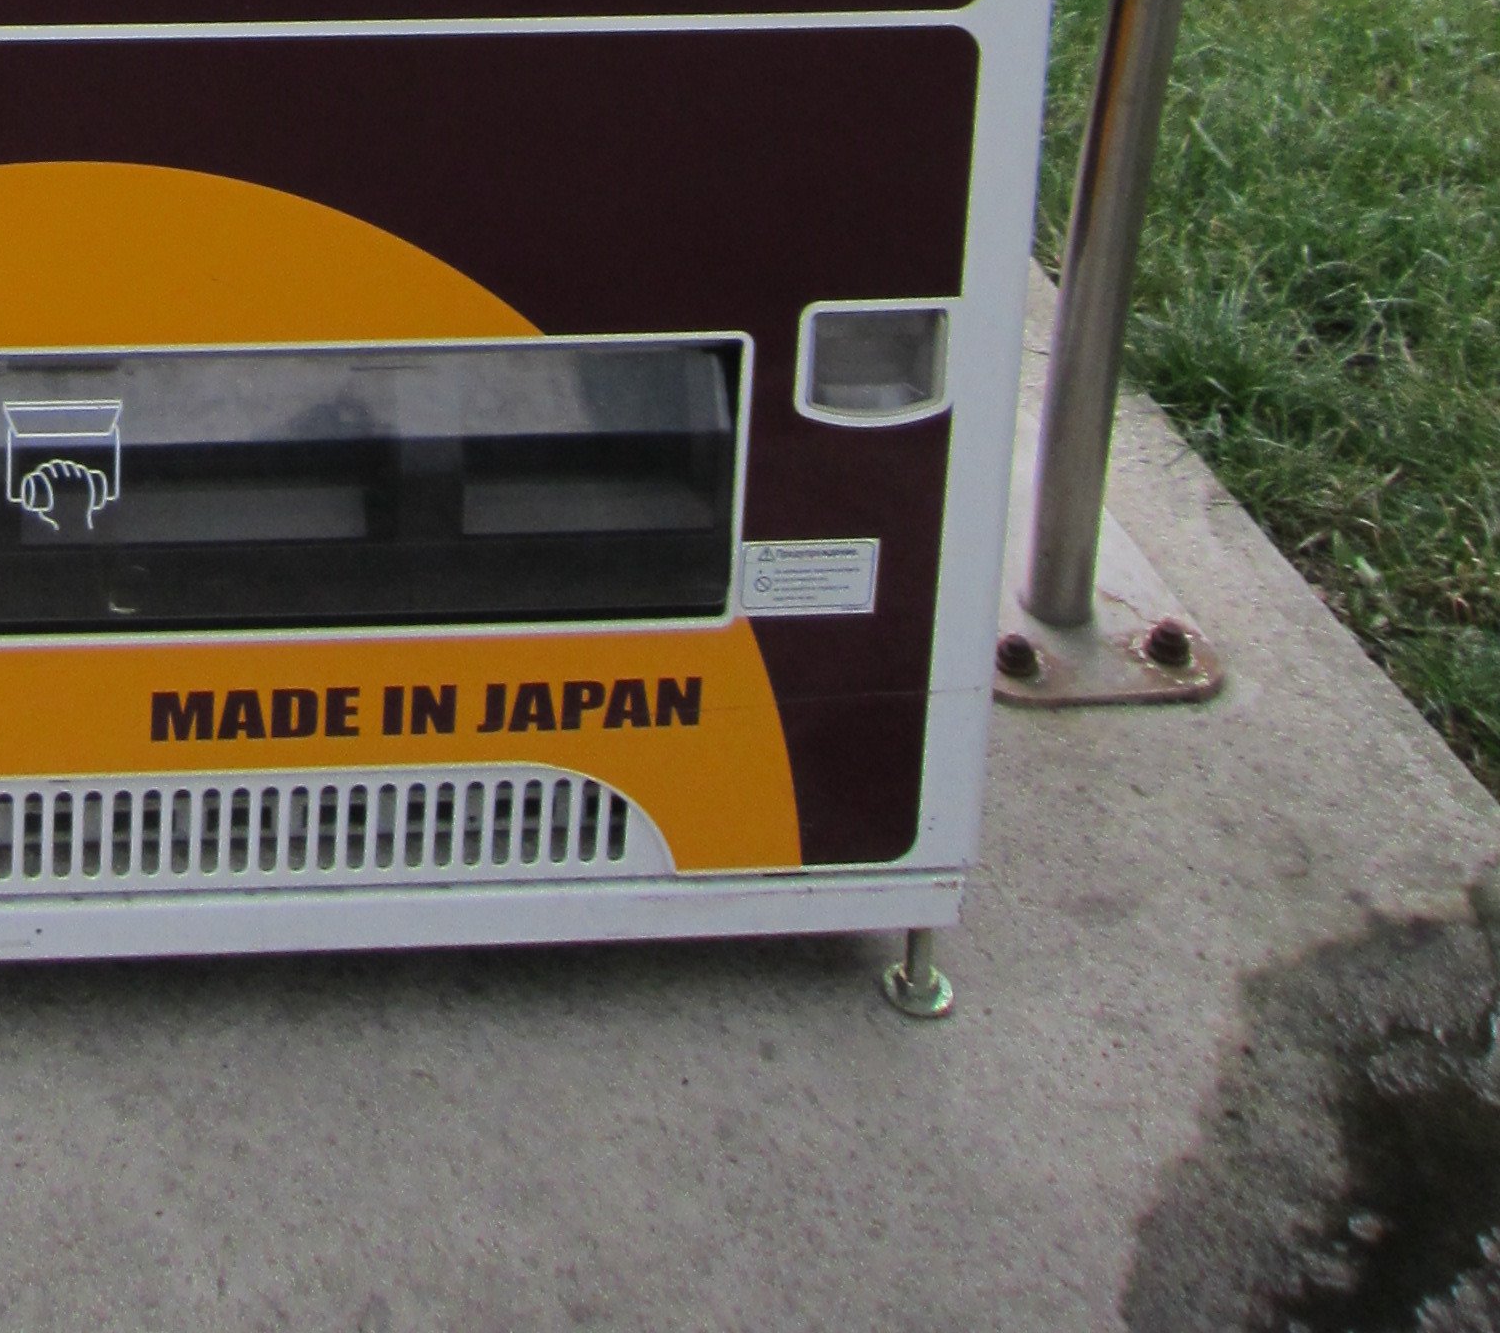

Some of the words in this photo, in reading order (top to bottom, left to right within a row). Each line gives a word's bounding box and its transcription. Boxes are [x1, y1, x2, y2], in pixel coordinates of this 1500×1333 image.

[150, 686, 360, 742] MADE
[382, 684, 457, 737] IN
[477, 675, 703, 734] JAPAN
